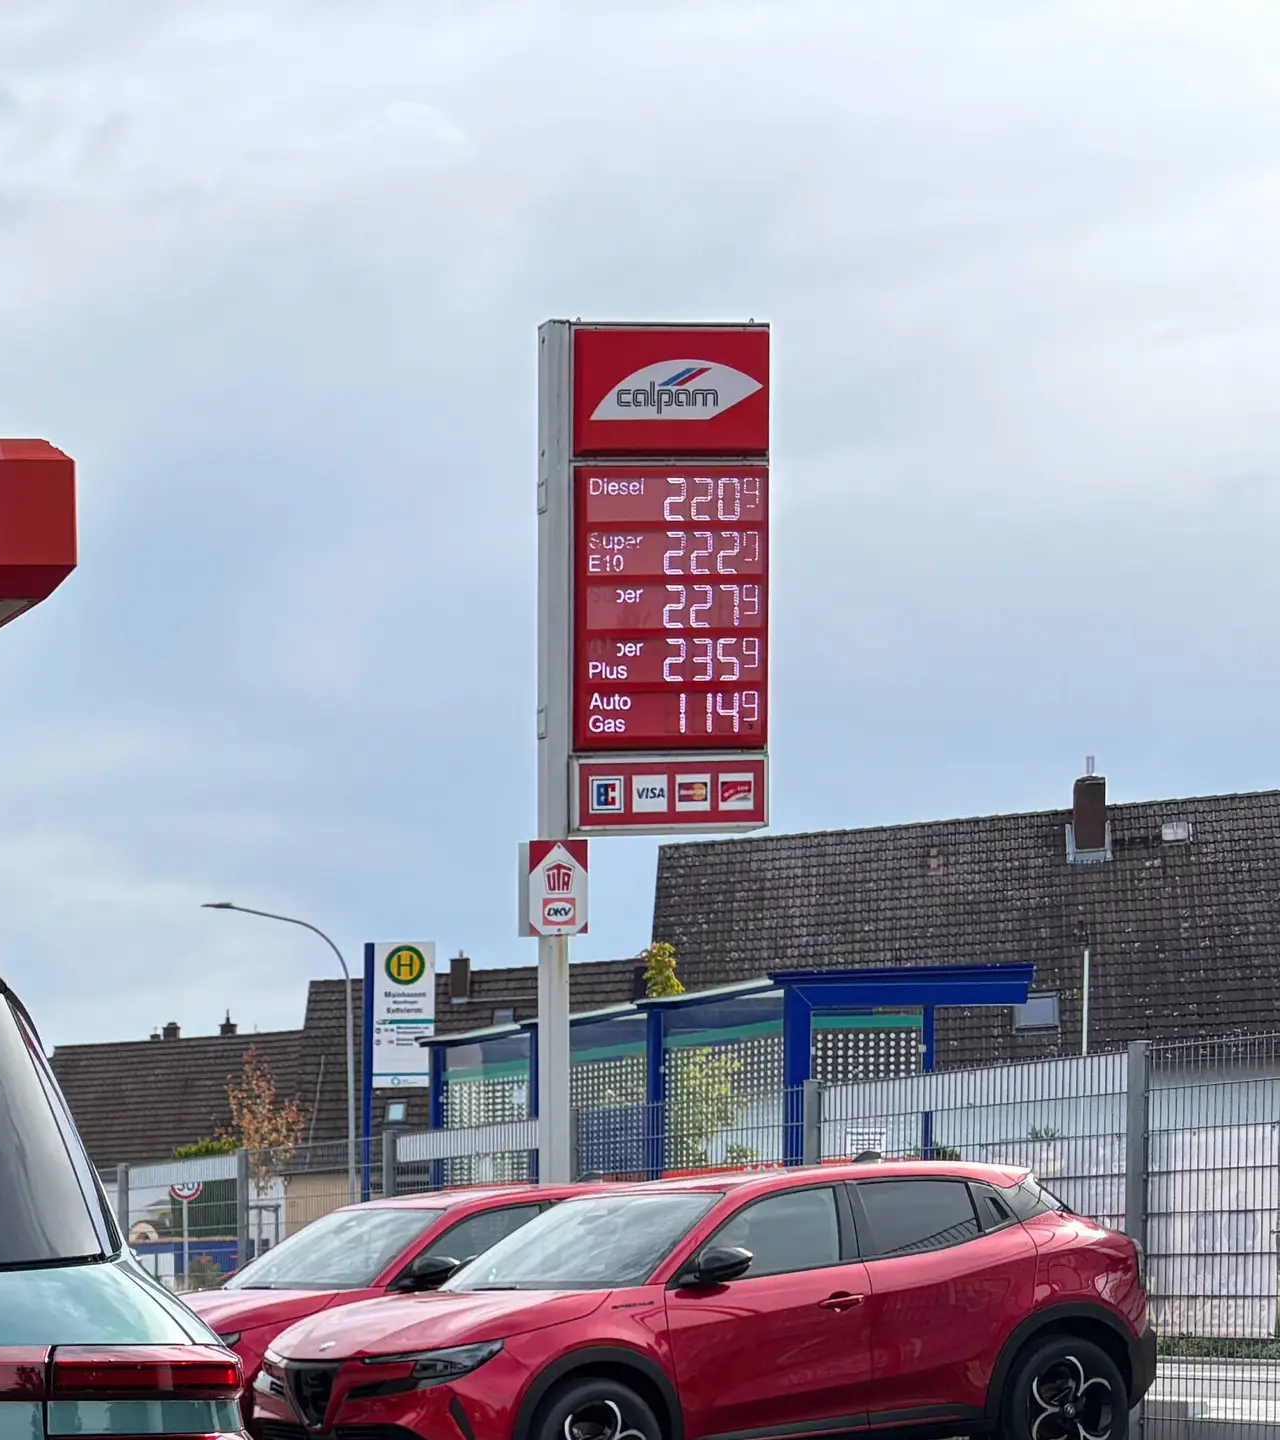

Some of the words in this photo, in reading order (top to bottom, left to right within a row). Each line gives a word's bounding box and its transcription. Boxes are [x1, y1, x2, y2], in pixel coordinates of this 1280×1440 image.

[616, 381, 719, 415] calpam
[589, 477, 644, 496] Diesel
[589, 555, 624, 572] E10
[589, 662, 628, 679] Plus
[589, 693, 631, 711] Auto
[589, 715, 626, 733] Gas
[636, 787, 666, 800] VISA
[546, 906, 572, 917] DKV
